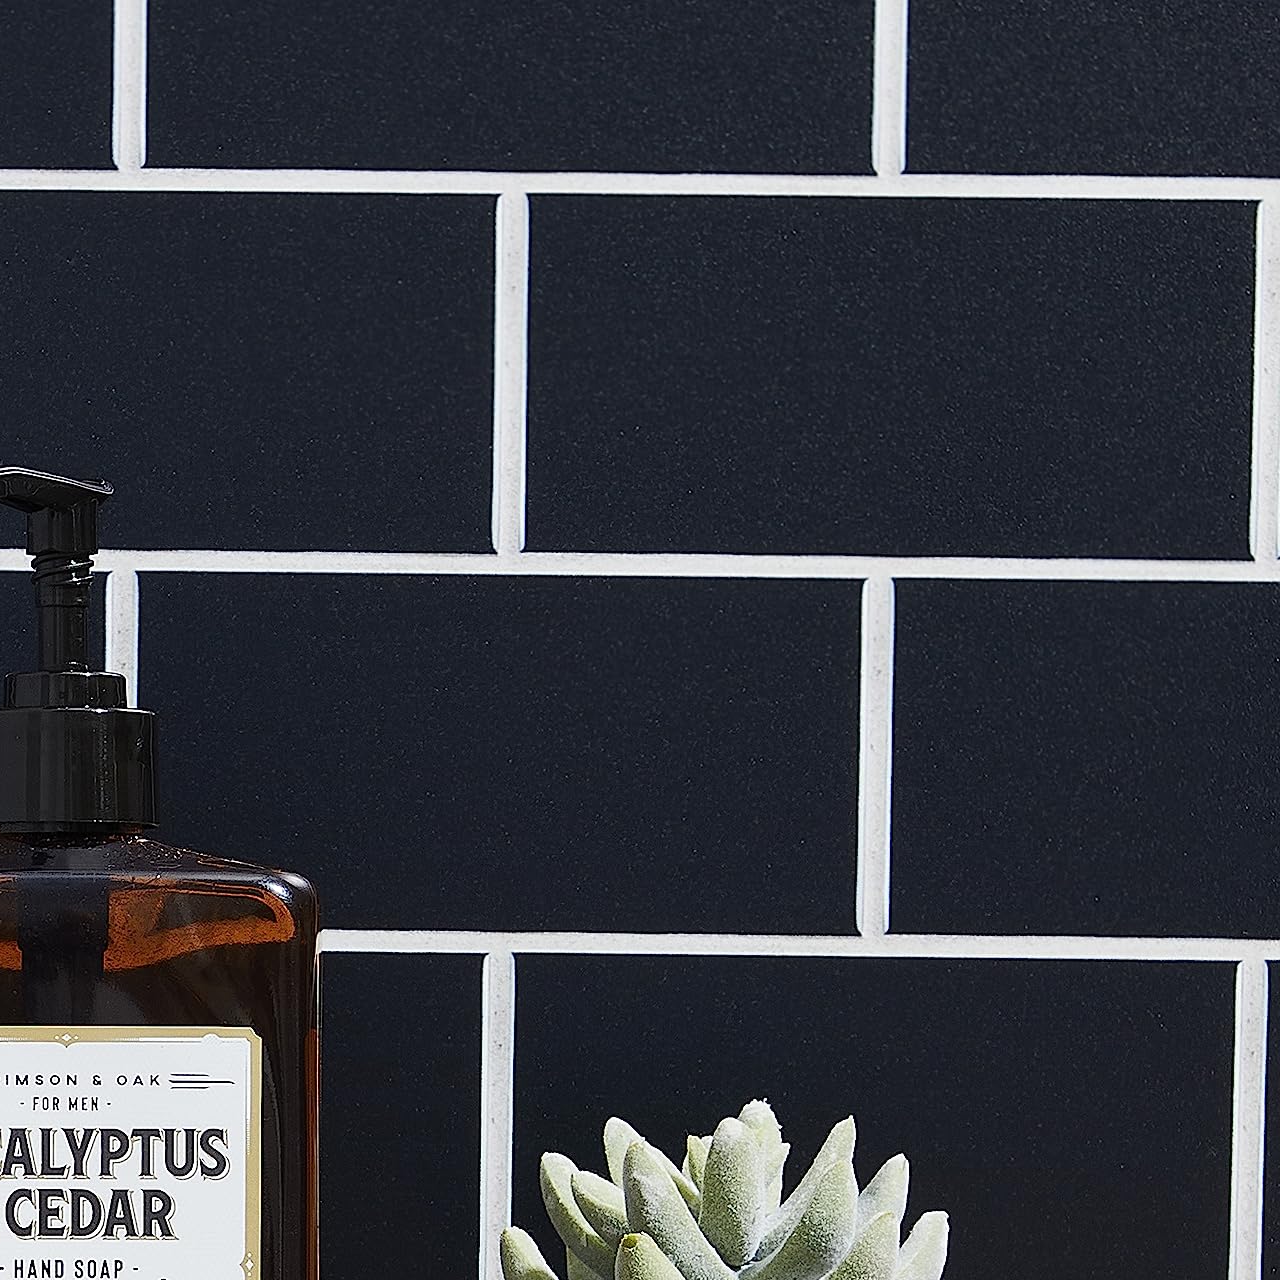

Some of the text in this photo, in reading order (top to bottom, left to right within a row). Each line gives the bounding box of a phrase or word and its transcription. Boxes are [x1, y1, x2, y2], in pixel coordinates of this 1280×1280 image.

[92, 1074, 102, 1086] &
[116, 1074, 161, 1086] OAK
[33, 1097, 100, 1111] FOR MEN
[5, 1188, 180, 1241] CEDAR
[14, 1260, 123, 1278] HAND SOAP
